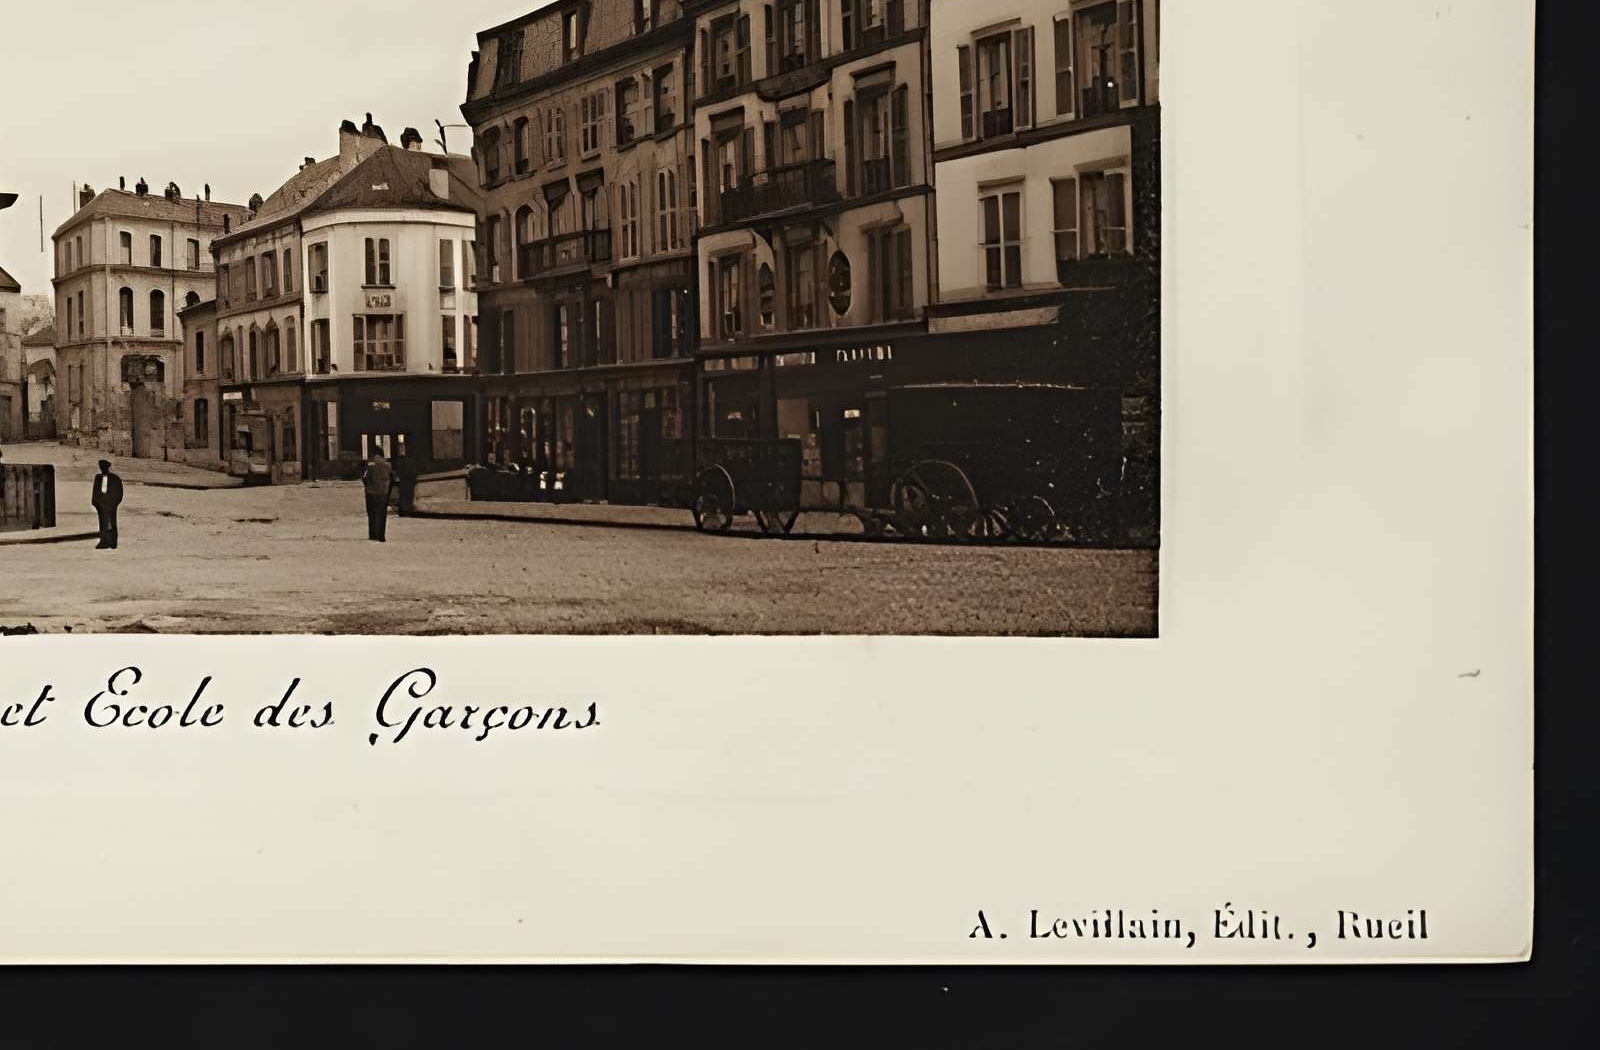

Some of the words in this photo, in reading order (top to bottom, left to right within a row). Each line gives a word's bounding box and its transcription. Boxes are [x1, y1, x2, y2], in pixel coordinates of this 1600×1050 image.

[0, 684, 56, 727] et
[83, 666, 224, 729] Ecole
[253, 677, 335, 729] des
[368, 667, 601, 746] Garçons
[968, 909, 1008, 940] A.
[1030, 909, 1196, 949] Levillain,
[1337, 909, 1428, 940] Rueil
